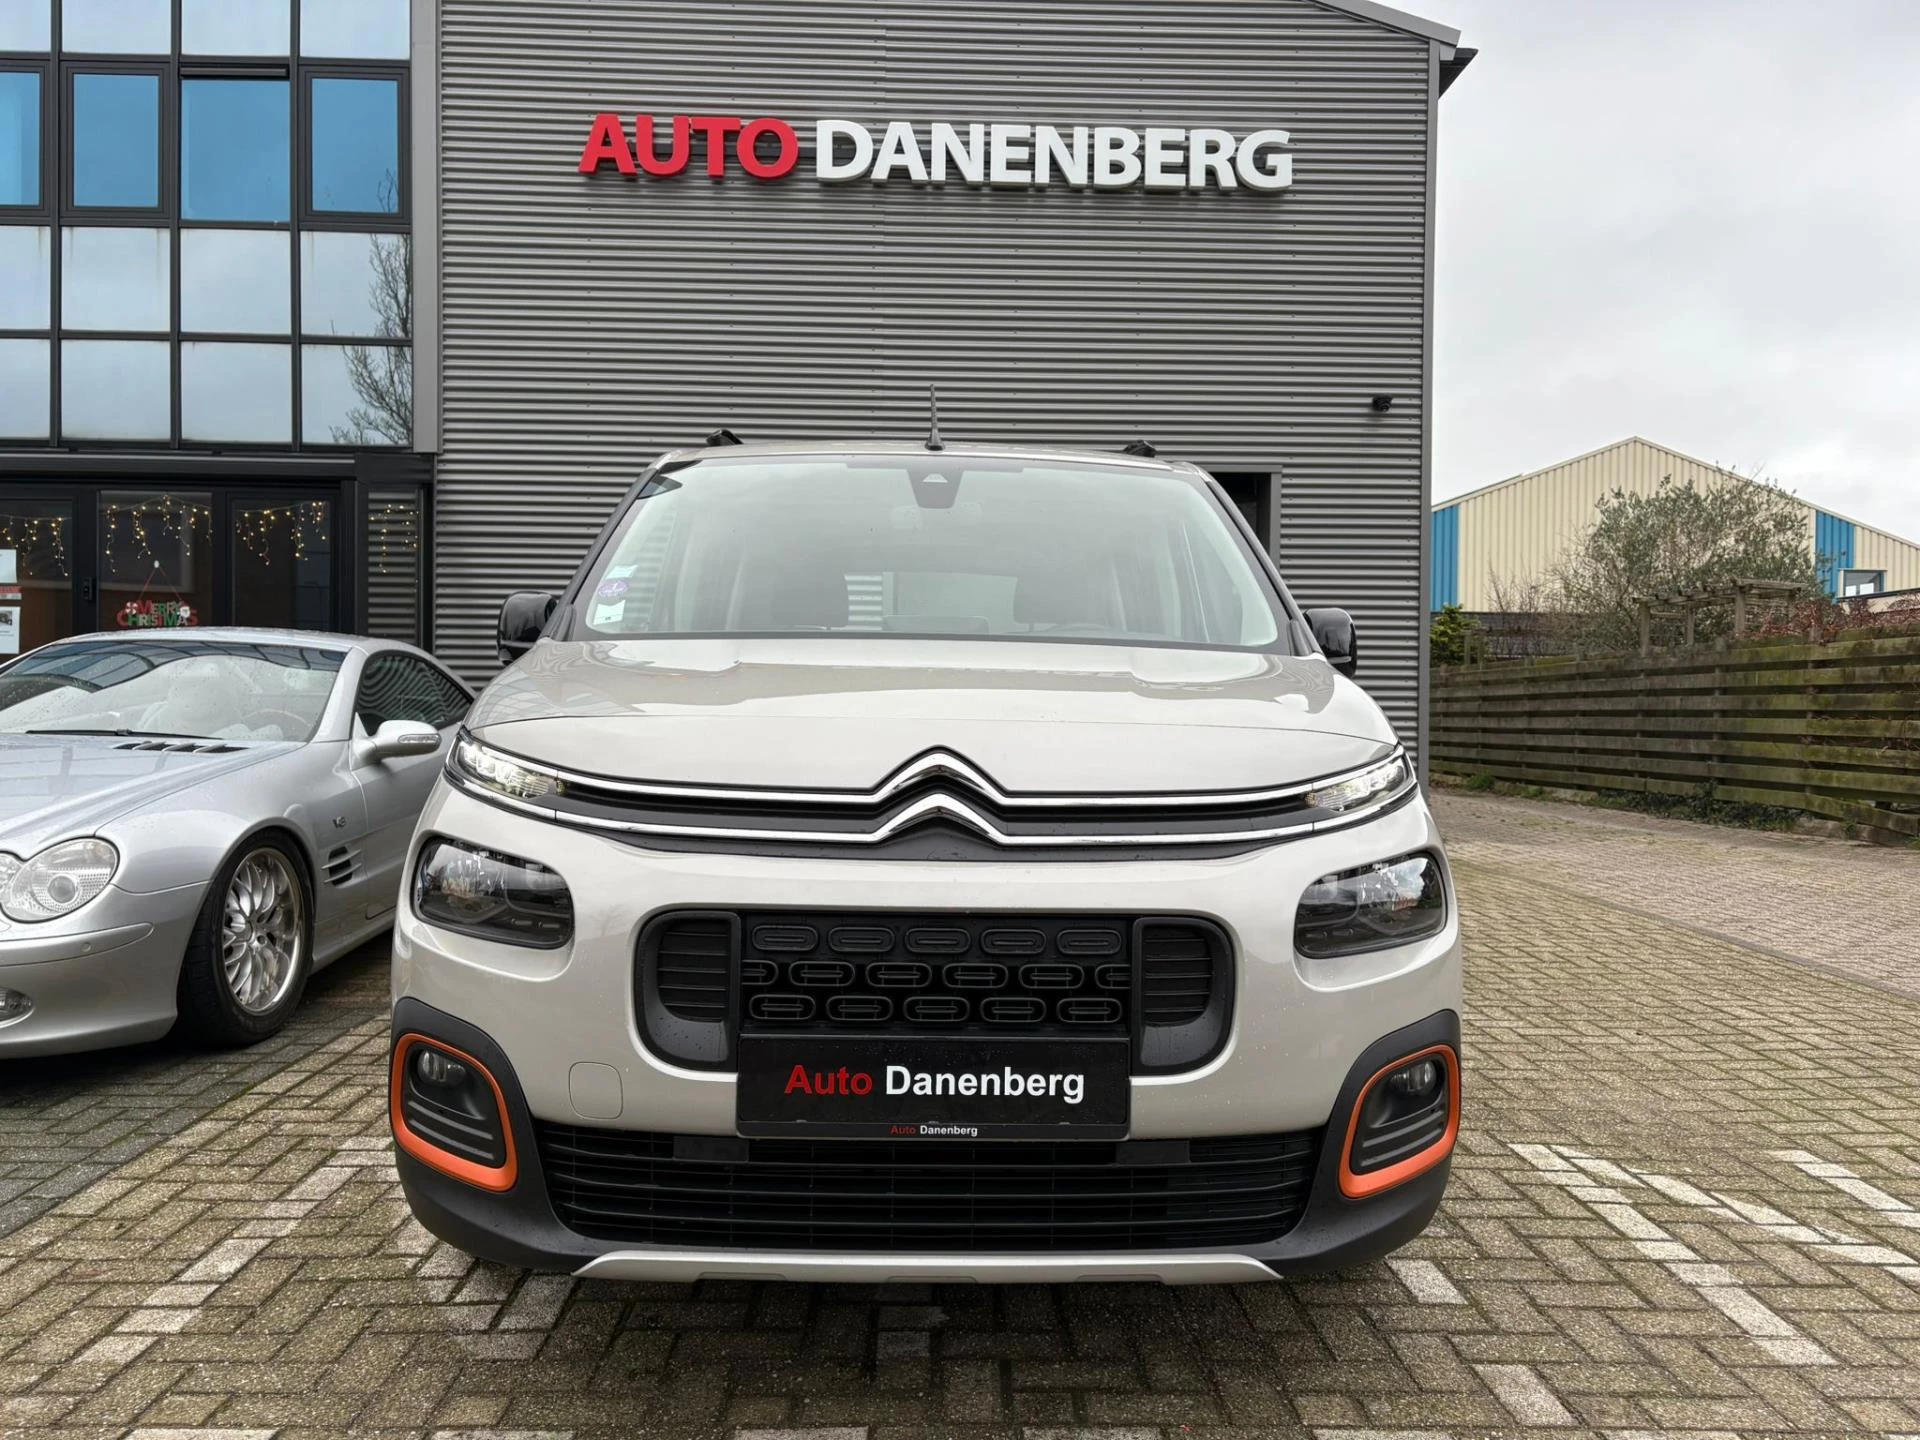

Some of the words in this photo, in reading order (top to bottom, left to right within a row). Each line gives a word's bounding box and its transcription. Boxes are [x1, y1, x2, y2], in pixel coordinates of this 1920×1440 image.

[577, 113, 799, 181] AUTO
[814, 117, 1294, 192] DANENBERG
[784, 1065, 873, 1096] Auto
[885, 1065, 1085, 1105] Danenberg
[890, 1125, 917, 1135] Auto
[919, 1125, 978, 1137] Danenberg
